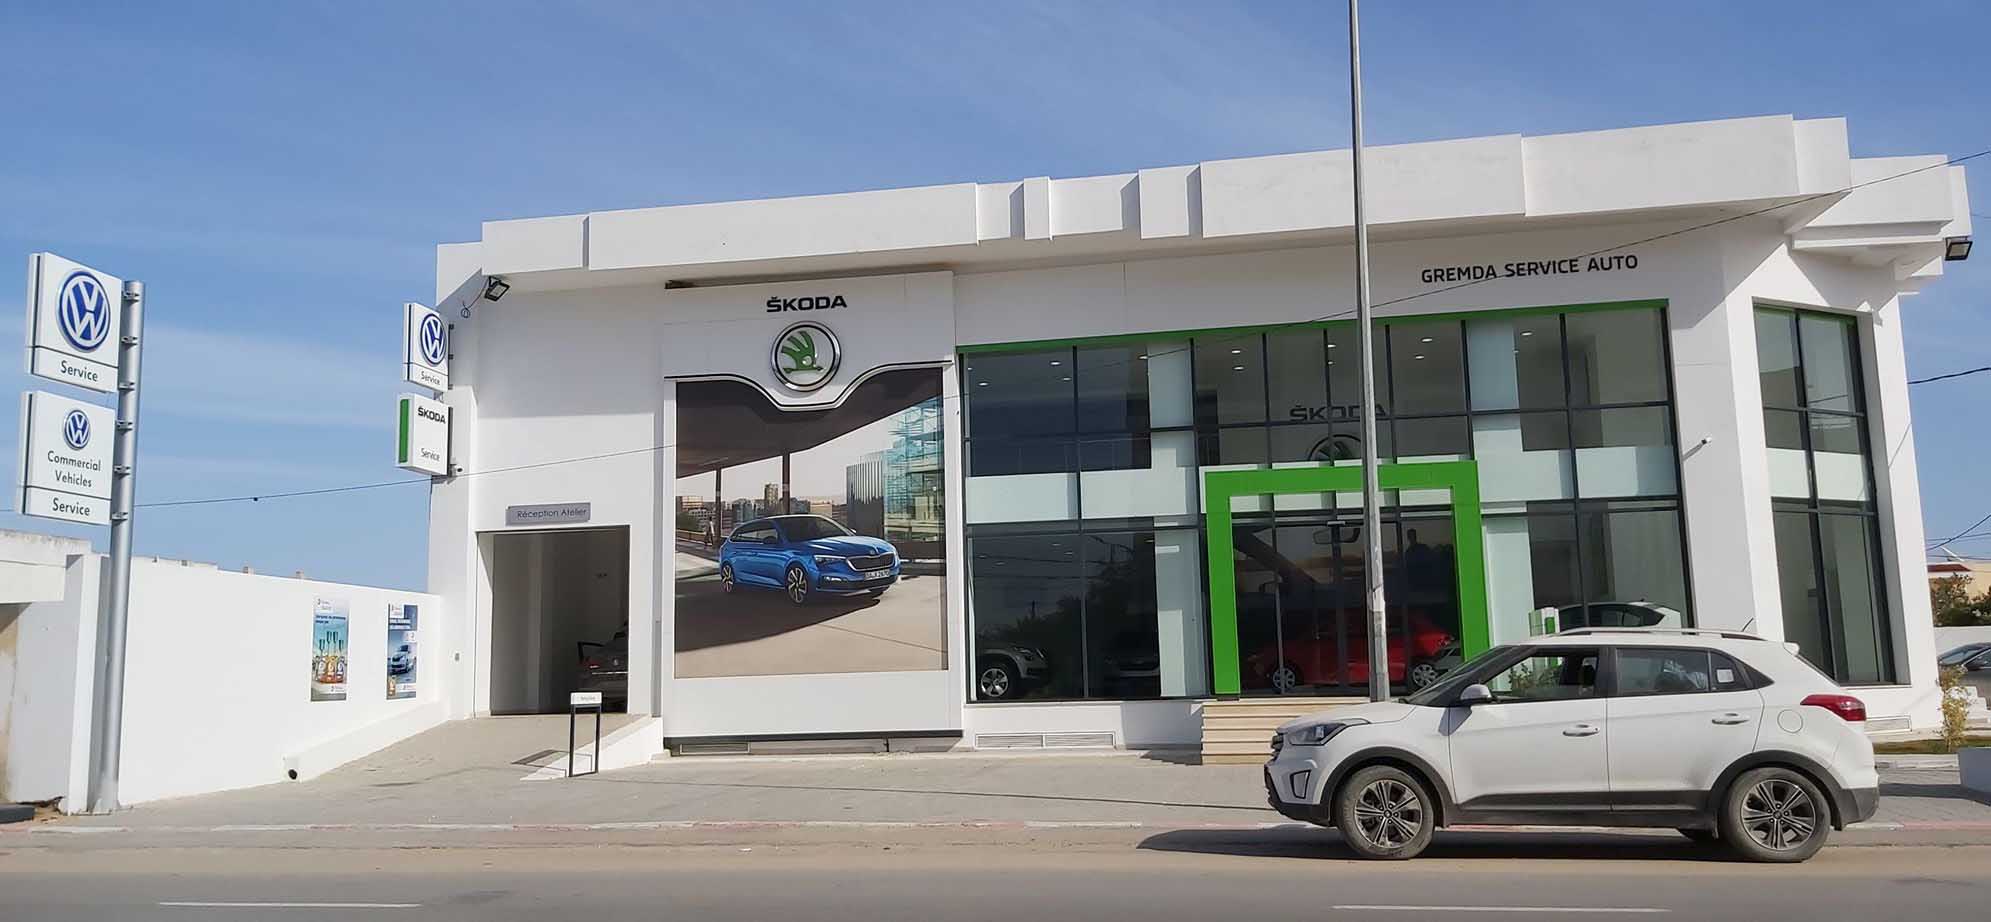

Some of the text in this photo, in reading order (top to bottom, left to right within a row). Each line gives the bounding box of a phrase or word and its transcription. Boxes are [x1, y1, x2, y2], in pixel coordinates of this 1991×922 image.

[1421, 254, 1639, 283] GREMDA SERVICE AUTO
[766, 295, 848, 313] ŠKODA
[60, 360, 99, 382] Service
[420, 370, 441, 386] Service
[47, 450, 101, 472] Commercial
[55, 469, 92, 488] Vehicles
[52, 497, 91, 517] Service
[560, 508, 587, 517] Atelier
